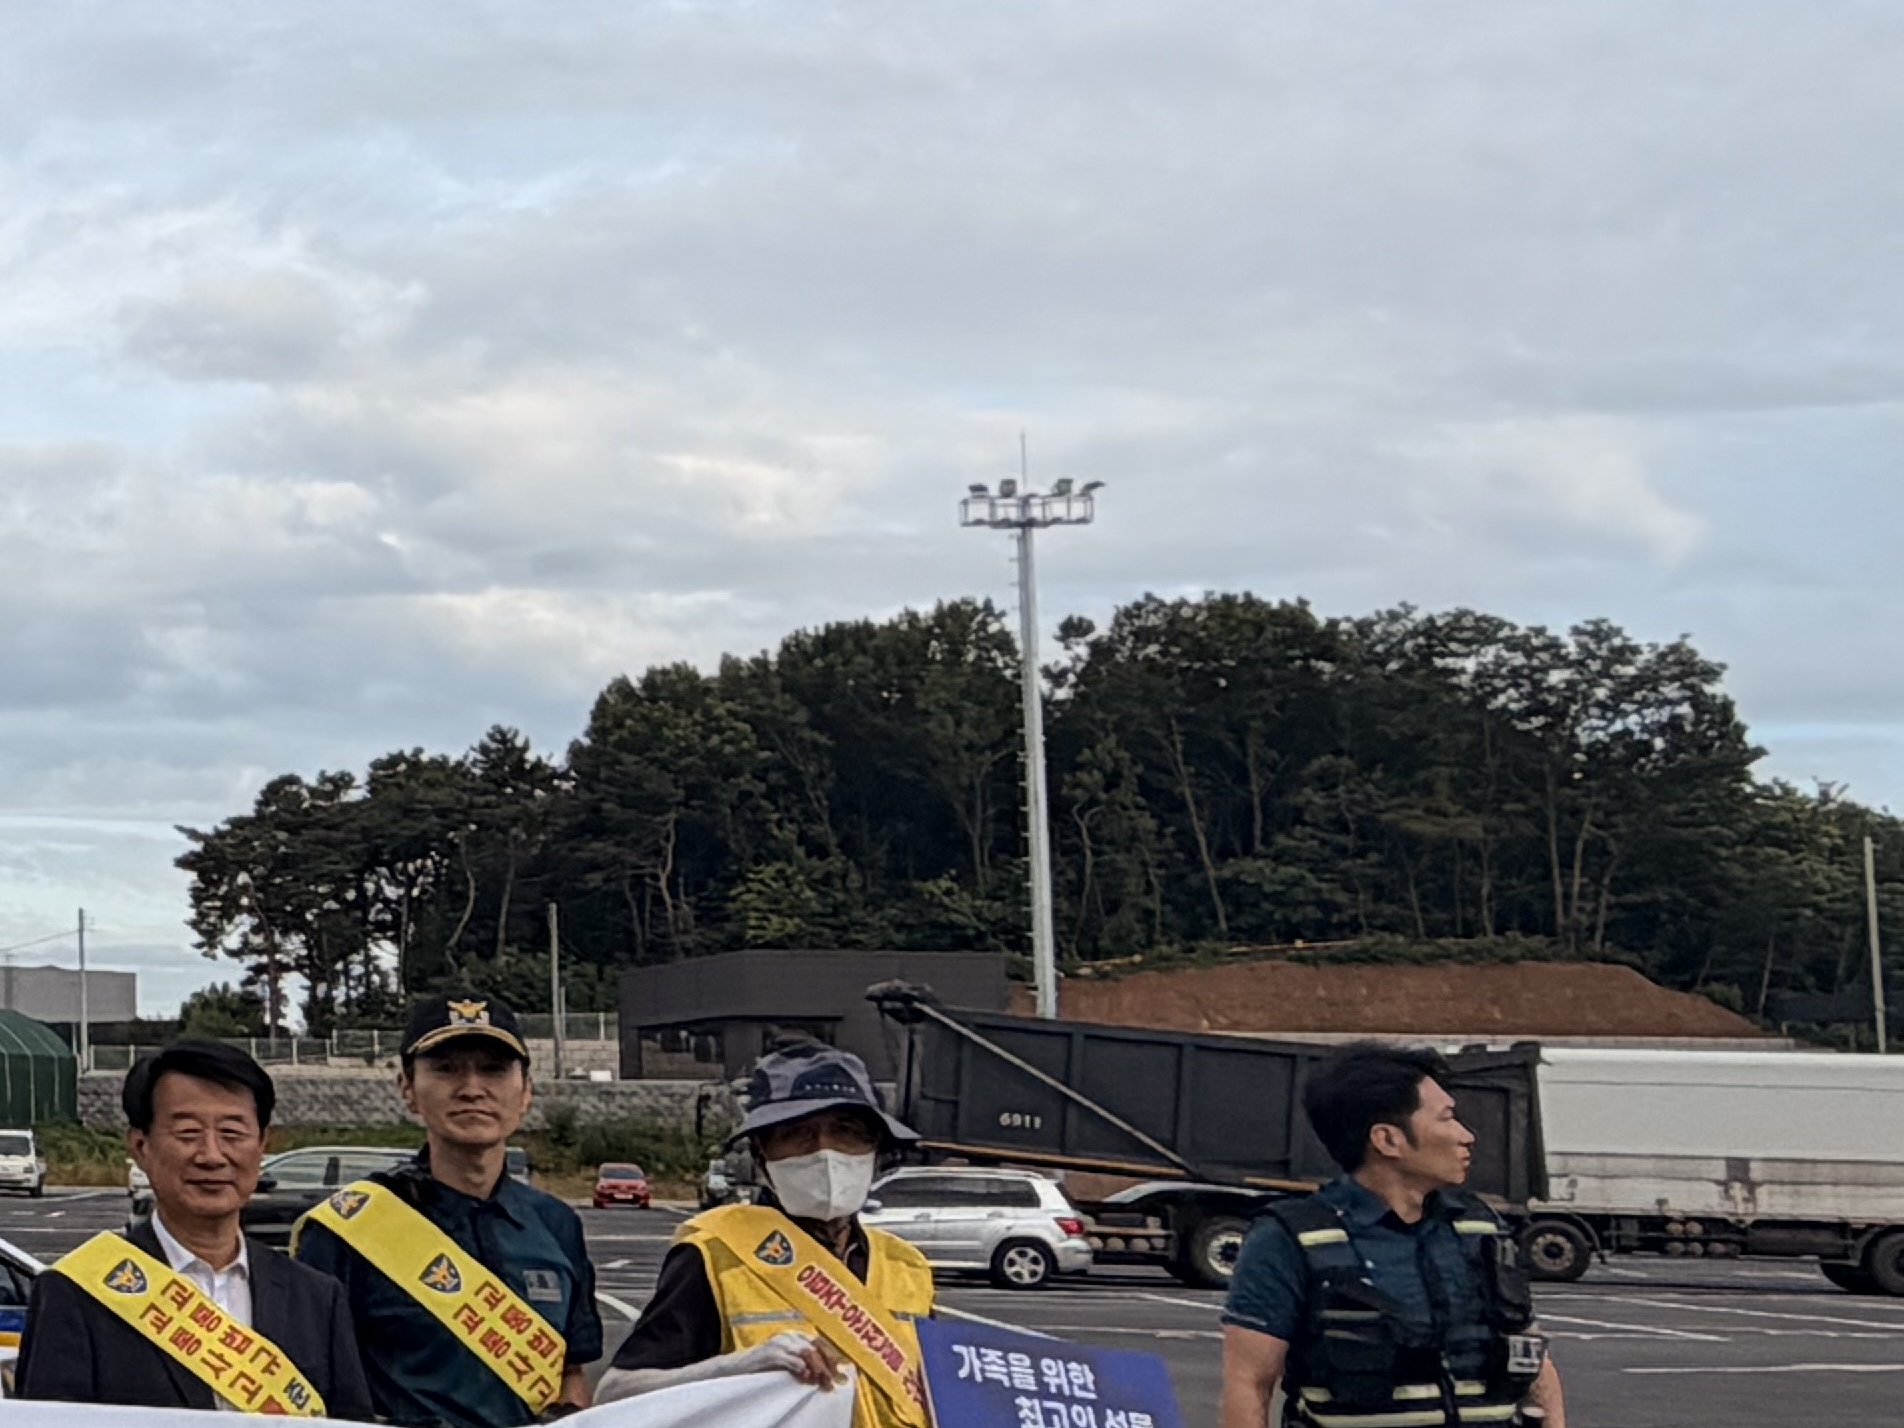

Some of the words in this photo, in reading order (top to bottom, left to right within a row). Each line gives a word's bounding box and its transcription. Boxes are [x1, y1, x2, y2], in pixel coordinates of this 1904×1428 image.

[160, 1278, 281, 1376] 교통법규
[951, 1344, 1038, 1392] 가족을
[1041, 1357, 1098, 1400] 위한
